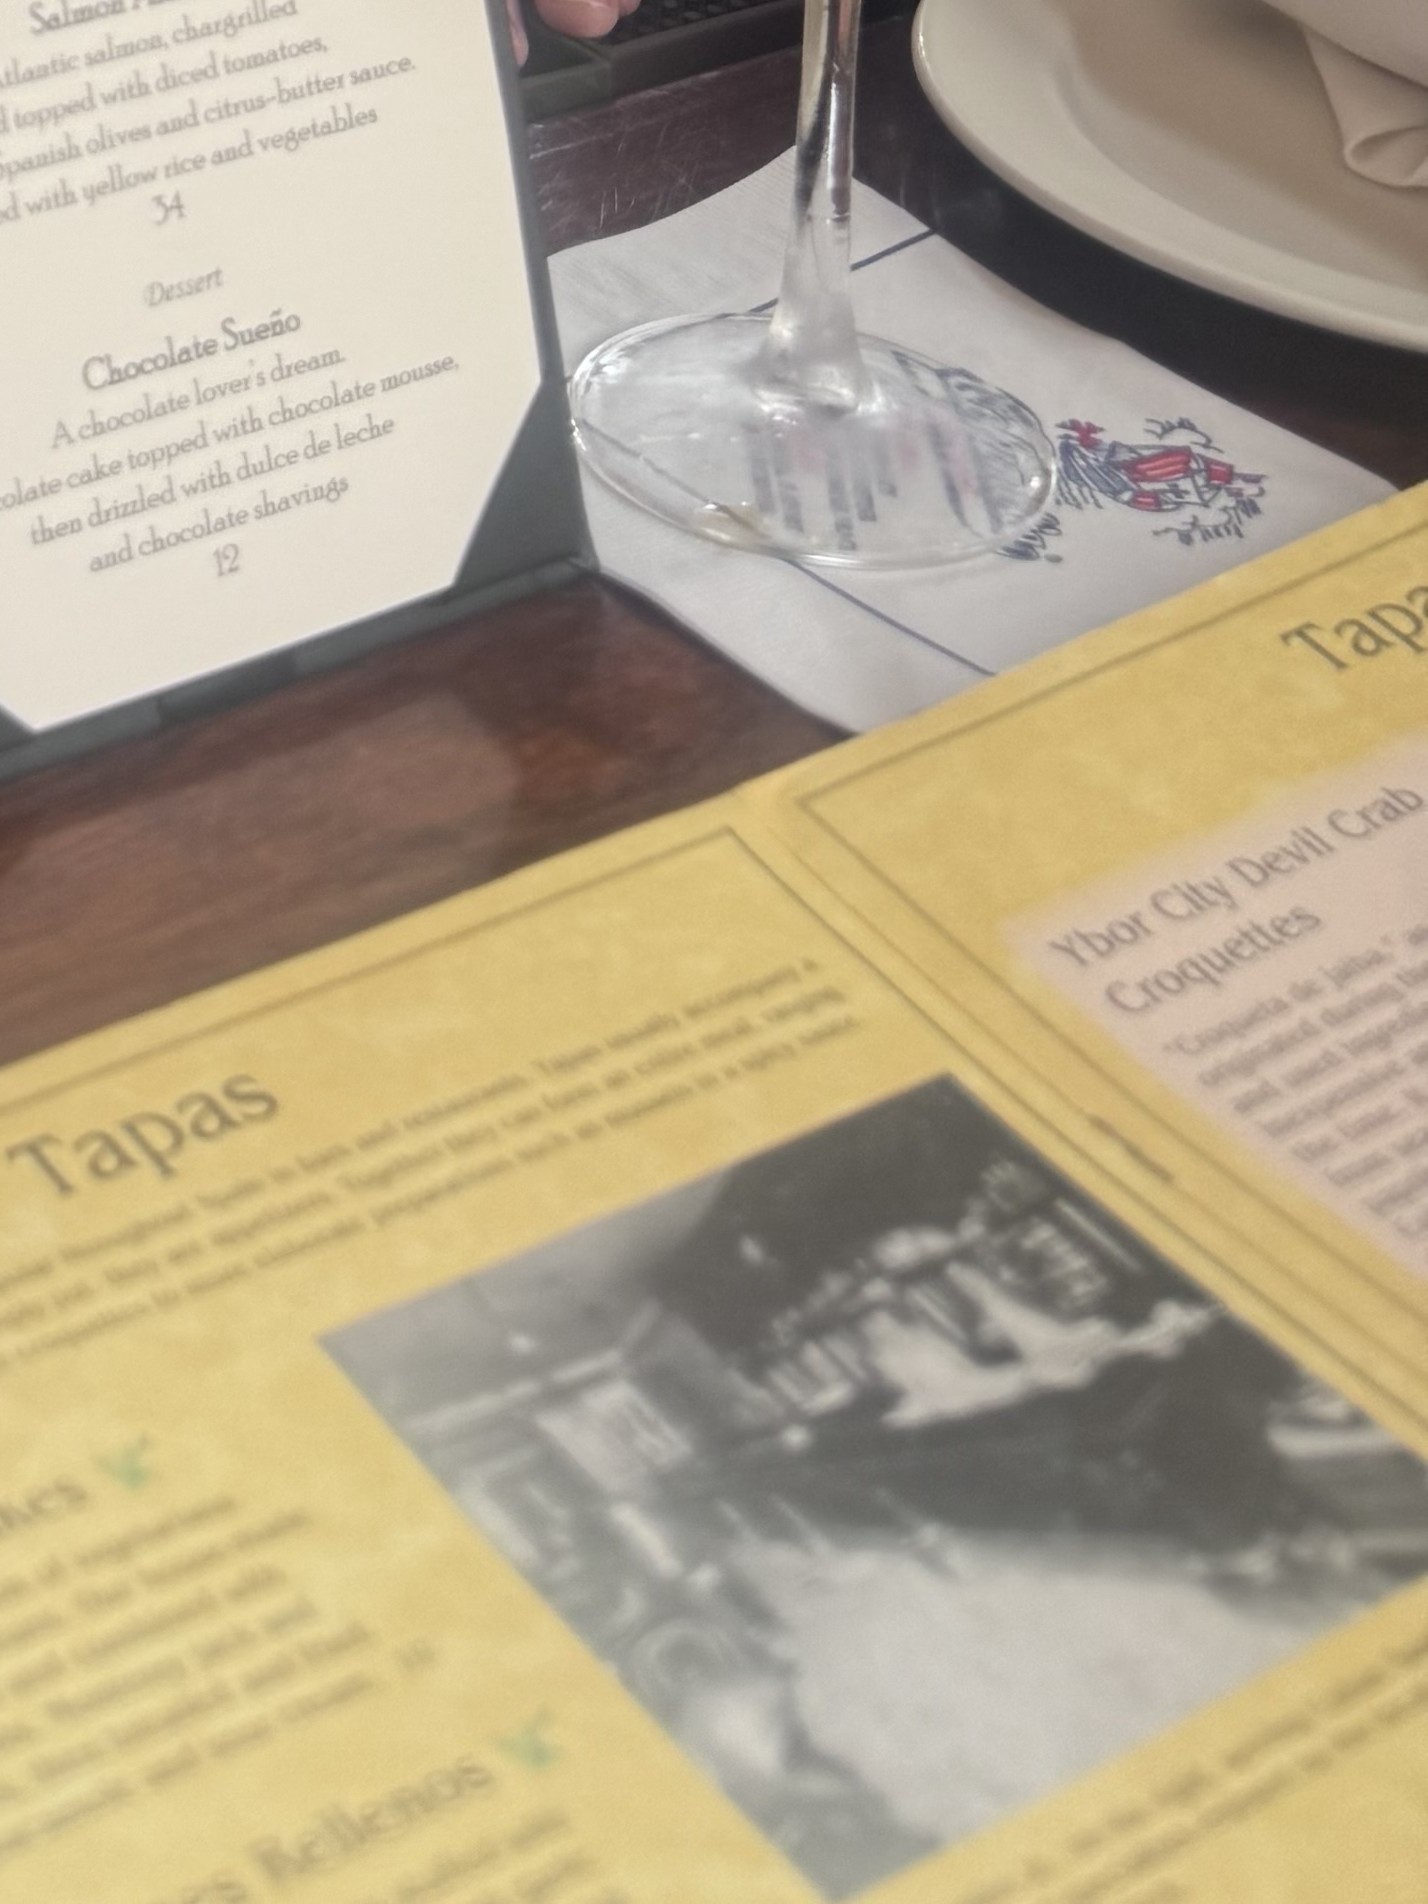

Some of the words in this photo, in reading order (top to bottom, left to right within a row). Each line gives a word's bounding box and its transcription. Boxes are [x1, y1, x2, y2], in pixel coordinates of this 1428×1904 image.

[11, 83, 99, 133] topped
[98, 69, 154, 109] with
[153, 53, 222, 96] diced
[82, 33, 170, 70] salmon,
[22, 176, 80, 216] with
[80, 163, 159, 211] yellow
[161, 152, 208, 181] rice
[208, 130, 256, 168] and
[255, 103, 380, 158] vegetables
[83, 121, 154, 155] olives
[153, 99, 202, 137] and
[142, 265, 224, 309] Dessert
[80, 330, 220, 390] Chocolate
[218, 307, 302, 352] Sueño
[51, 418, 74, 449] A
[78, 391, 191, 442] chocolate
[63, 450, 125, 490] cake
[125, 419, 211, 473] topped
[210, 402, 266, 444] with
[266, 376, 377, 428] chocolate
[28, 511, 85, 546] then
[85, 473, 178, 528] drizzled
[178, 456, 235, 499] with
[234, 444, 301, 482] dulce
[301, 431, 333, 462] de
[332, 411, 396, 453] leche
[87, 533, 136, 573] and
[136, 508, 250, 559] chocolate
[251, 480, 350, 525] shavings
[212, 543, 241, 578] 12
[1049, 910, 1154, 970] Ybor
[1148, 875, 1238, 924] City
[1225, 824, 1335, 890] Devil
[1325, 785, 1425, 841] Crab
[1103, 904, 1323, 1013] Croquettes
[4, 1069, 281, 1202] Tapas
